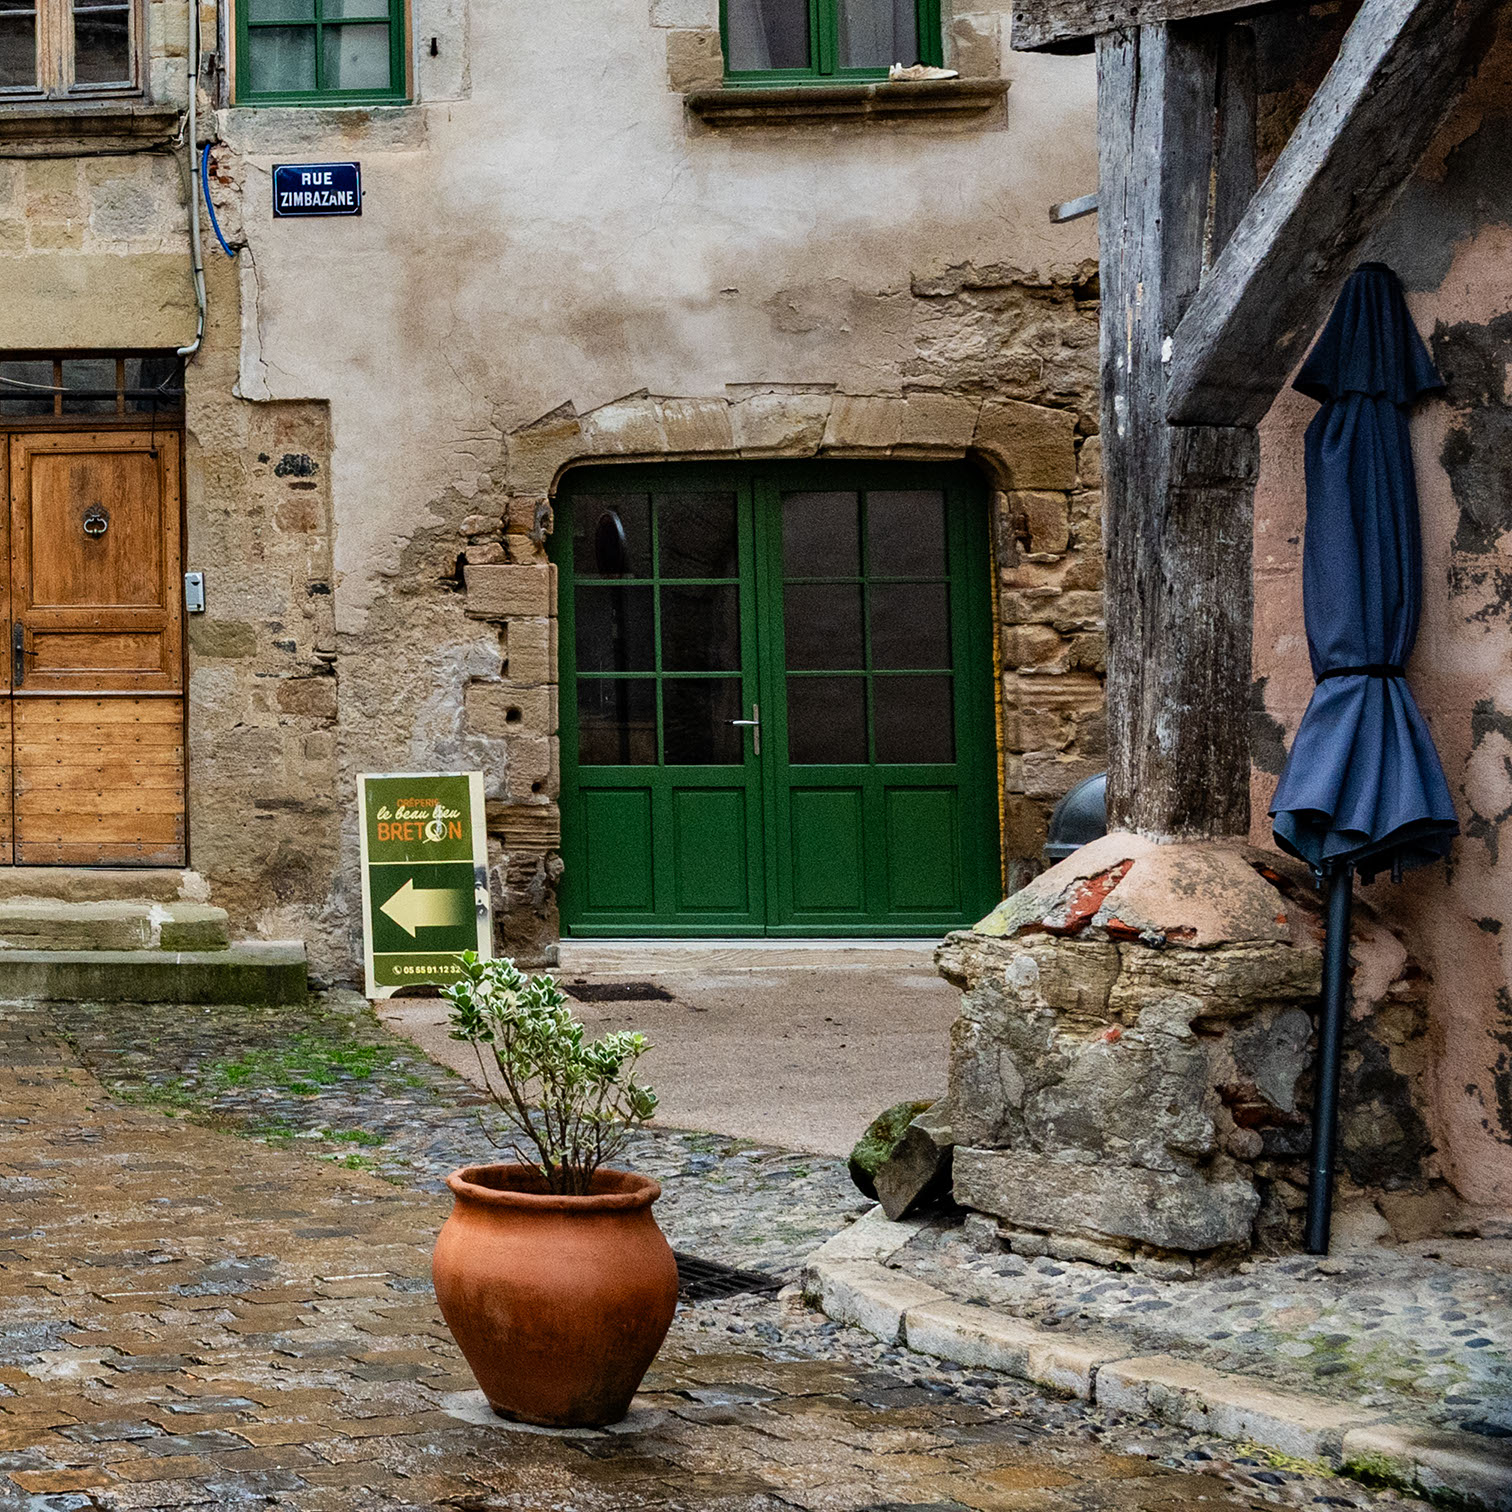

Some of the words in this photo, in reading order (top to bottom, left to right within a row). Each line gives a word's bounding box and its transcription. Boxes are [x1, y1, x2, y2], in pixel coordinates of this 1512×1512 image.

[301, 172, 333, 186] RUE
[280, 191, 355, 207] ZIMBAZANE
[377, 805, 392, 820] le
[395, 804, 429, 820] beau
[432, 804, 461, 819] lieu
[377, 820, 462, 843] BRETON
[403, 966, 414, 975] 05
[439, 966, 449, 975] 12
